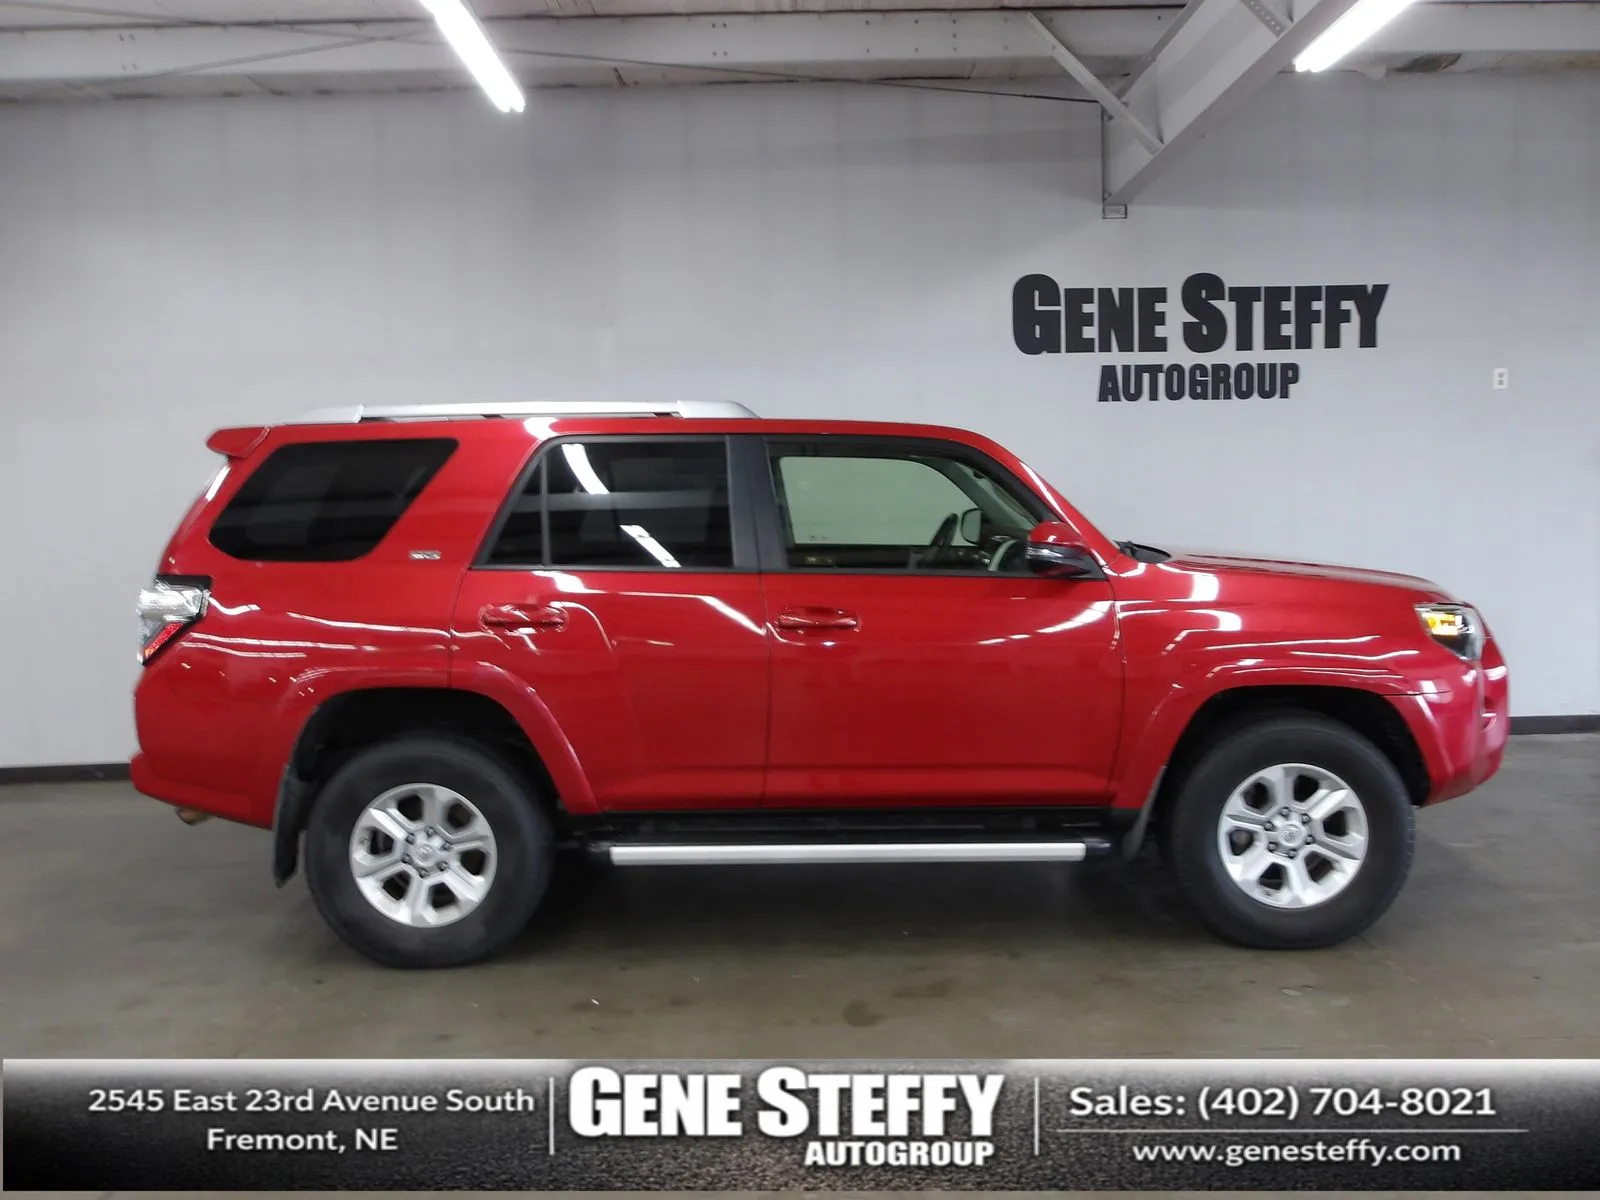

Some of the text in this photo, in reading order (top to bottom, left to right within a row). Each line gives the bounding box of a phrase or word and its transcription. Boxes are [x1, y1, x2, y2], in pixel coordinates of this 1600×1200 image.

[1012, 272, 1390, 356] GENE STEFFY
[1097, 362, 1300, 403] AUTOGROUP
